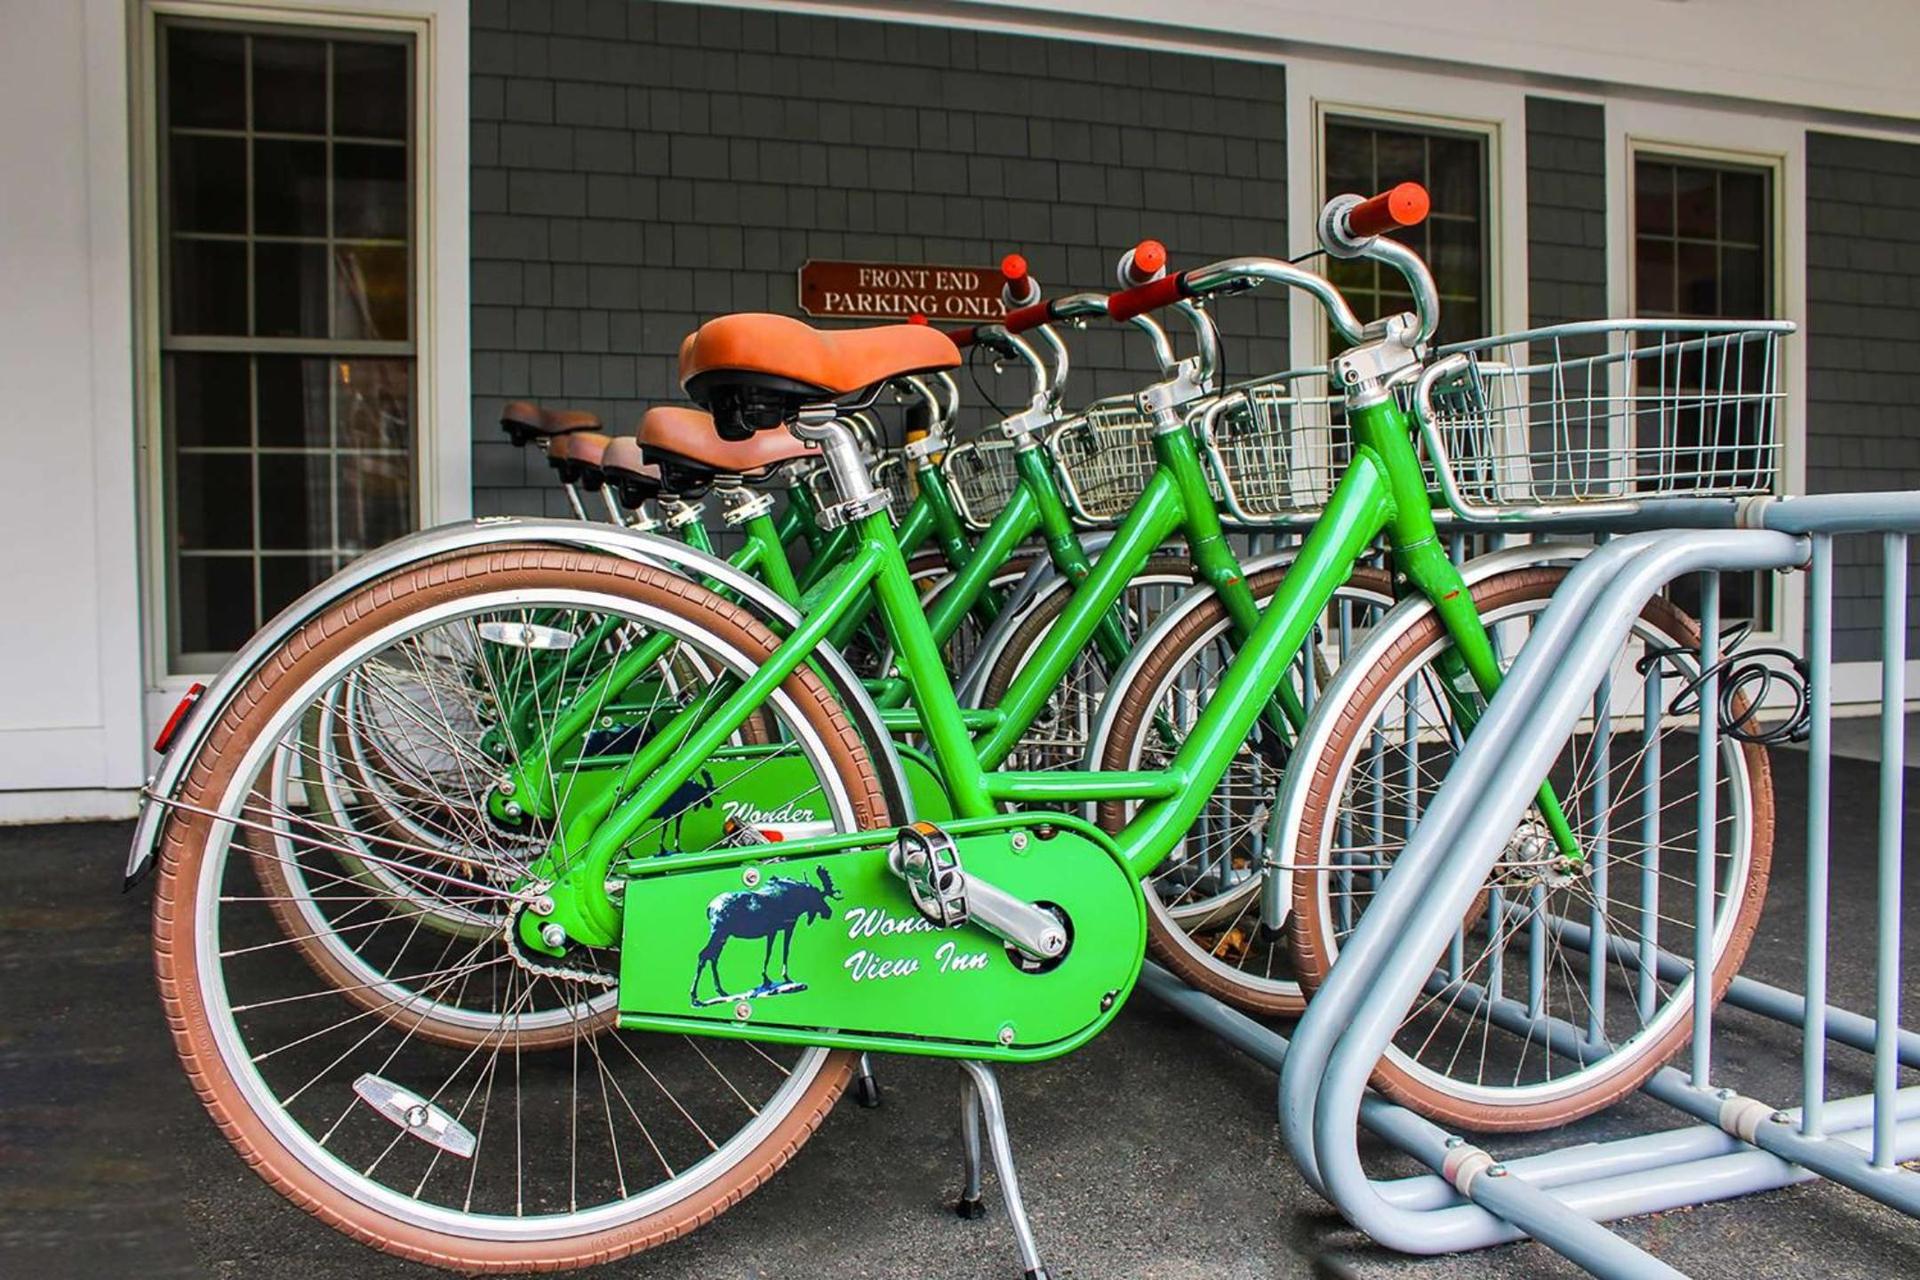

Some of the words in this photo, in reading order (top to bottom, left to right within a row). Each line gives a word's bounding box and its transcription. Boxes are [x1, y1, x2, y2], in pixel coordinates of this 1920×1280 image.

[859, 268, 931, 290] FRONT
[936, 271, 979, 291] END
[825, 292, 938, 315] PARKING
[945, 297, 1008, 317] ONLY
[721, 800, 815, 823] Wonder
[844, 950, 920, 982] View
[934, 941, 989, 974] Inn
